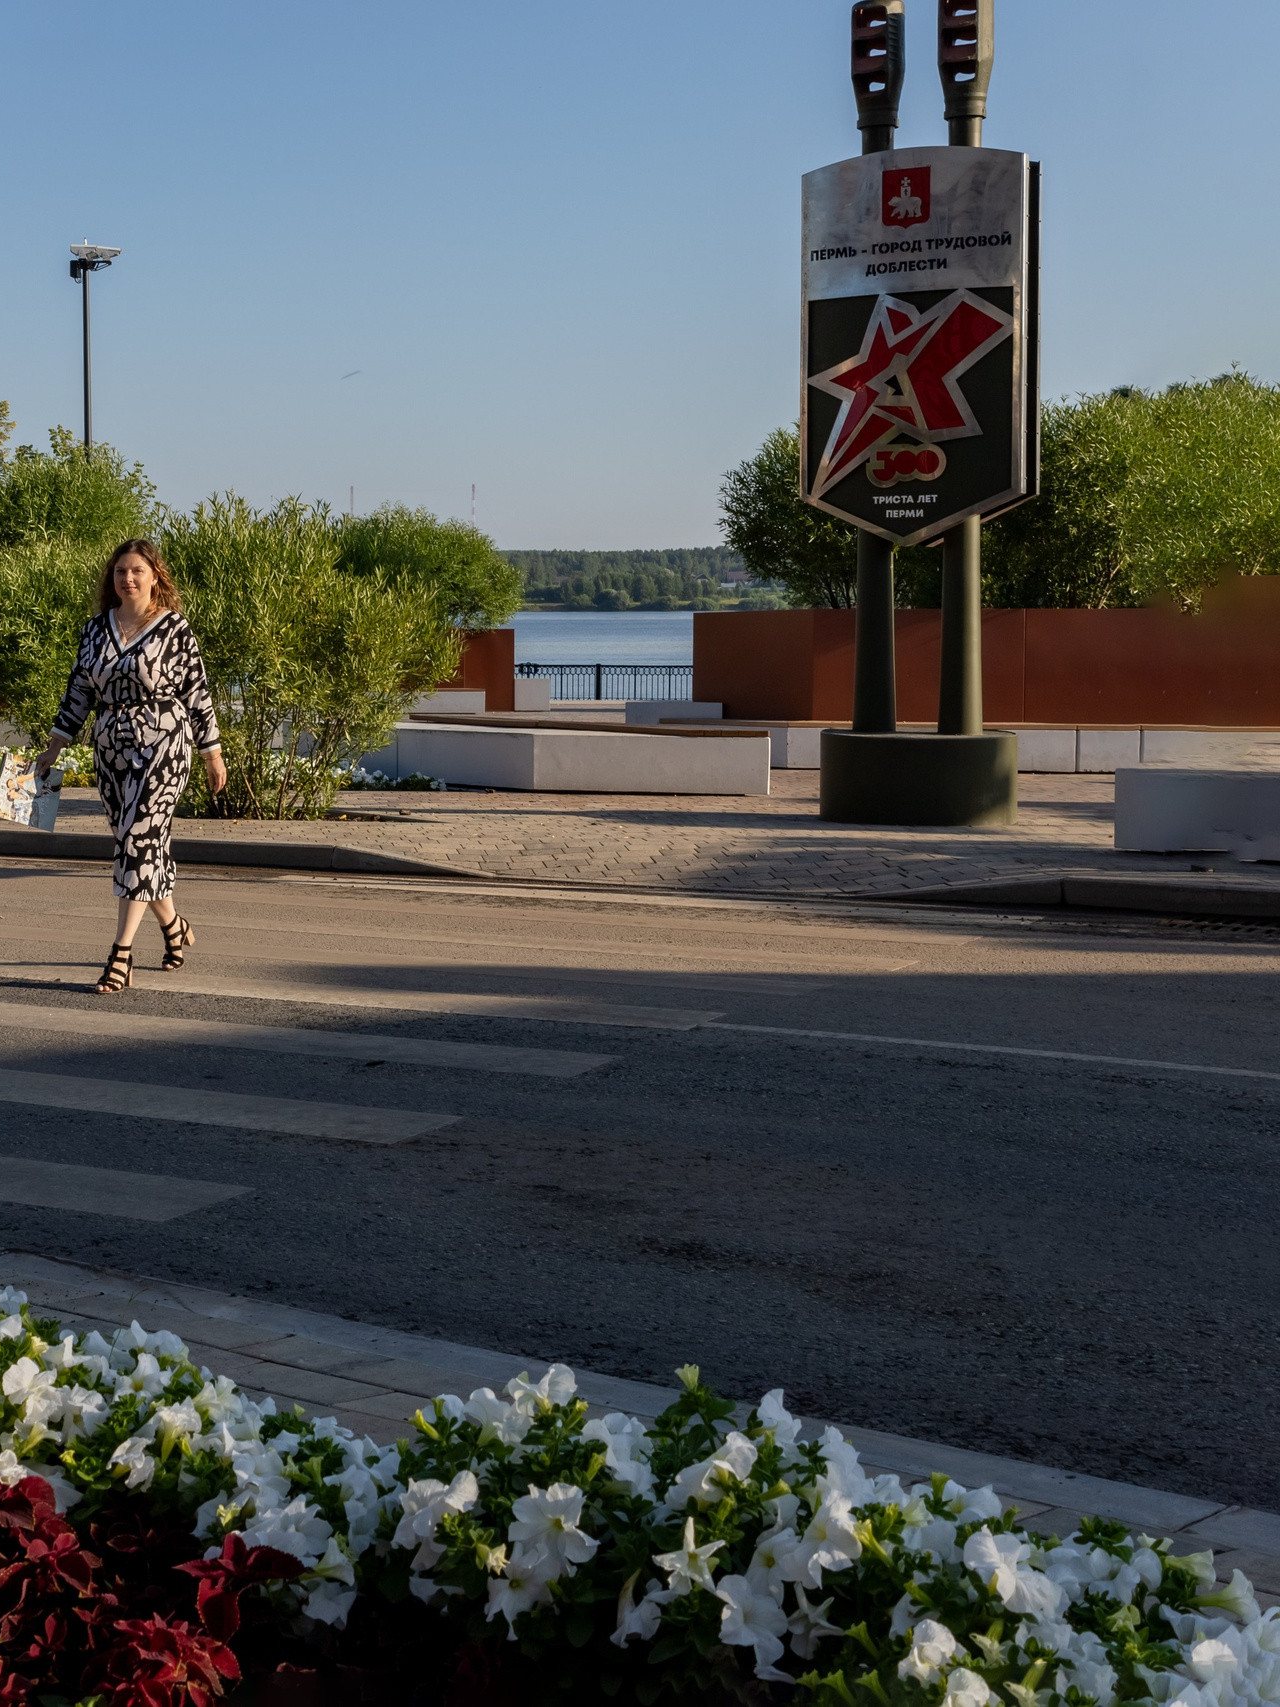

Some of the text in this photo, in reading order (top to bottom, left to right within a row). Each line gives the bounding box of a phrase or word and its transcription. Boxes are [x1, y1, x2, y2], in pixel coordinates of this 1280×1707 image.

[810, 246, 857, 261] ПЕРМЬ
[871, 240, 922, 255] ГОРОД
[925, 231, 1012, 250] ТРУДОВОЙ
[865, 258, 947, 277] ДОБЛЕСТИ
[870, 447, 943, 484] 300
[872, 494, 938, 504] ТРИСТА ЛЕТ
[885, 509, 924, 518] ПЕРМИ
